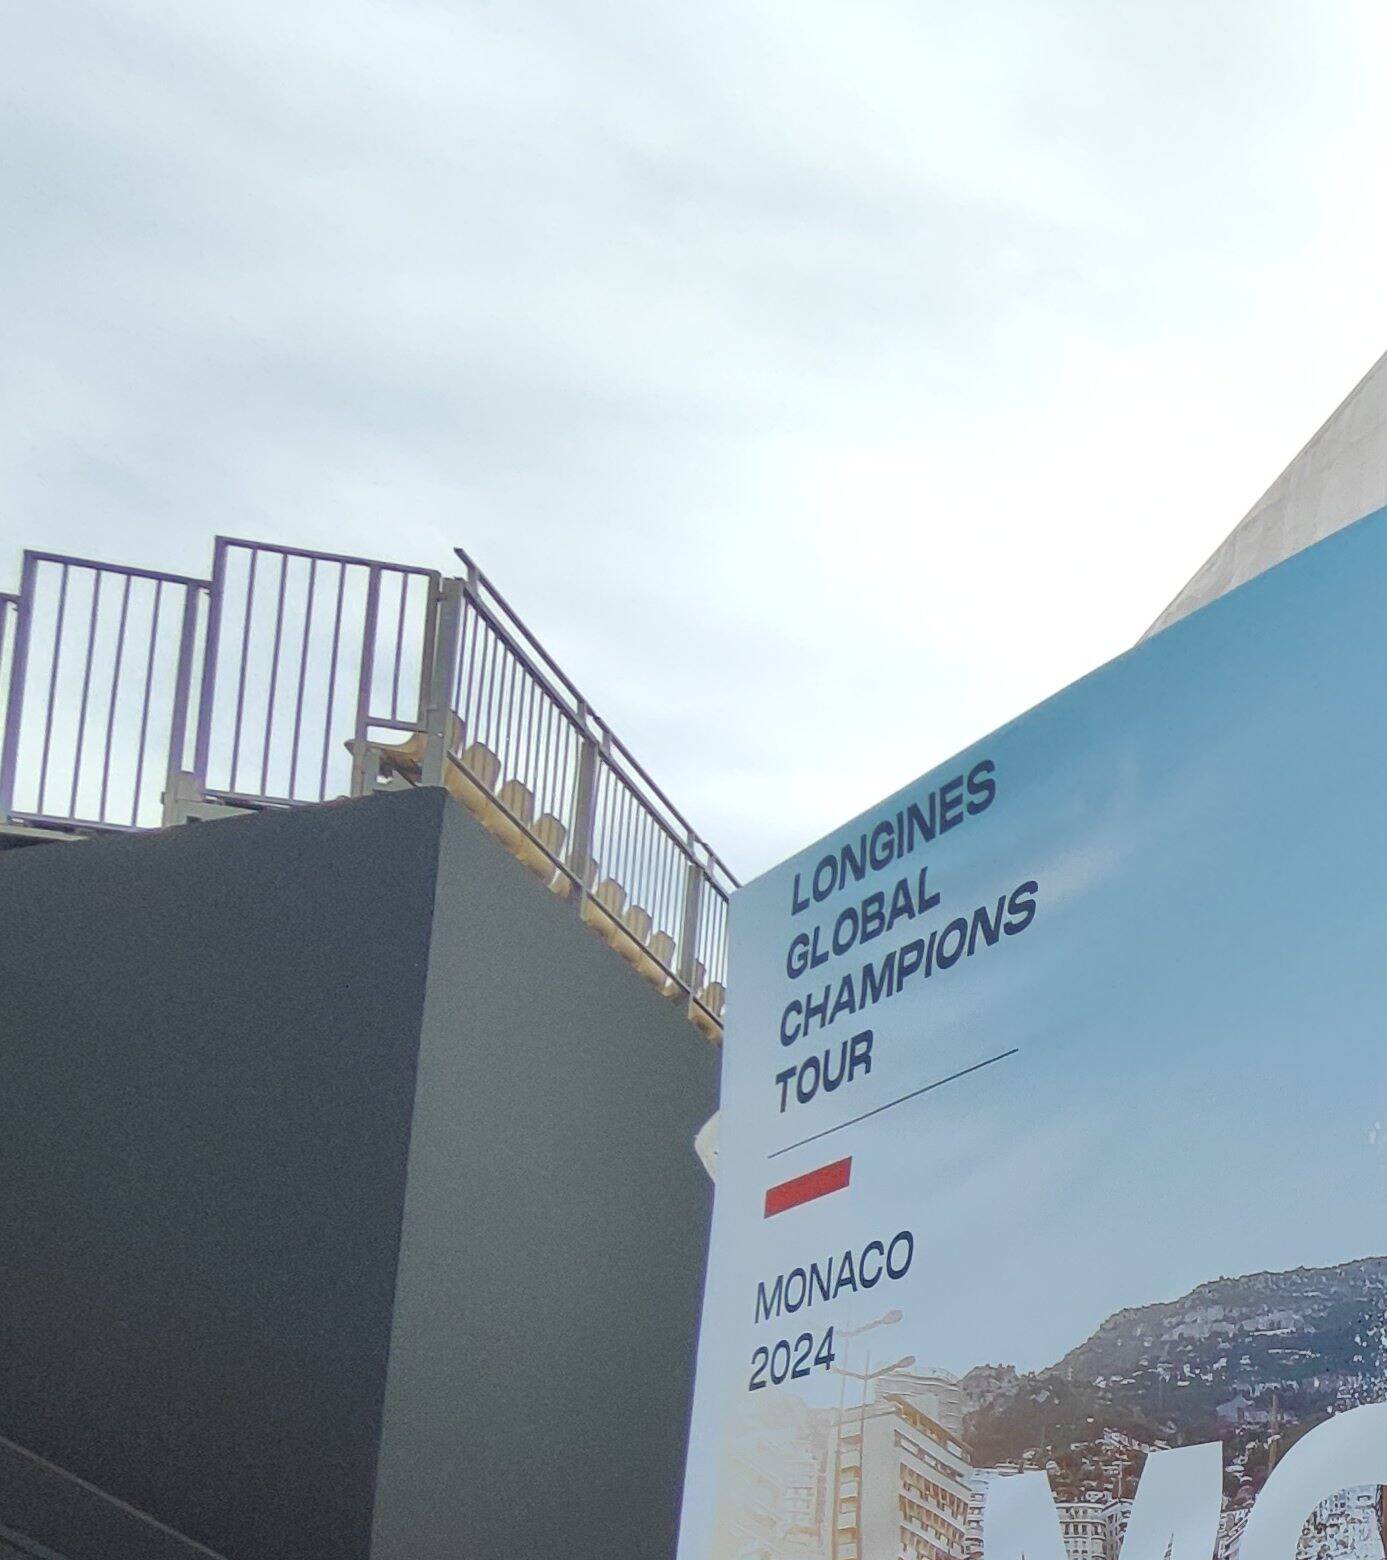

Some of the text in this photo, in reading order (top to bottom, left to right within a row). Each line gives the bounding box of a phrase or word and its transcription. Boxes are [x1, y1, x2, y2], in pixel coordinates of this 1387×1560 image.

[789, 758, 997, 916] LONGINES
[780, 880, 1039, 1047] CHAMPIONS
[786, 866, 941, 979] GLOBAL
[775, 1029, 874, 1113] TOUR
[754, 1230, 914, 1324] MONACO
[748, 1326, 836, 1391] 2024
